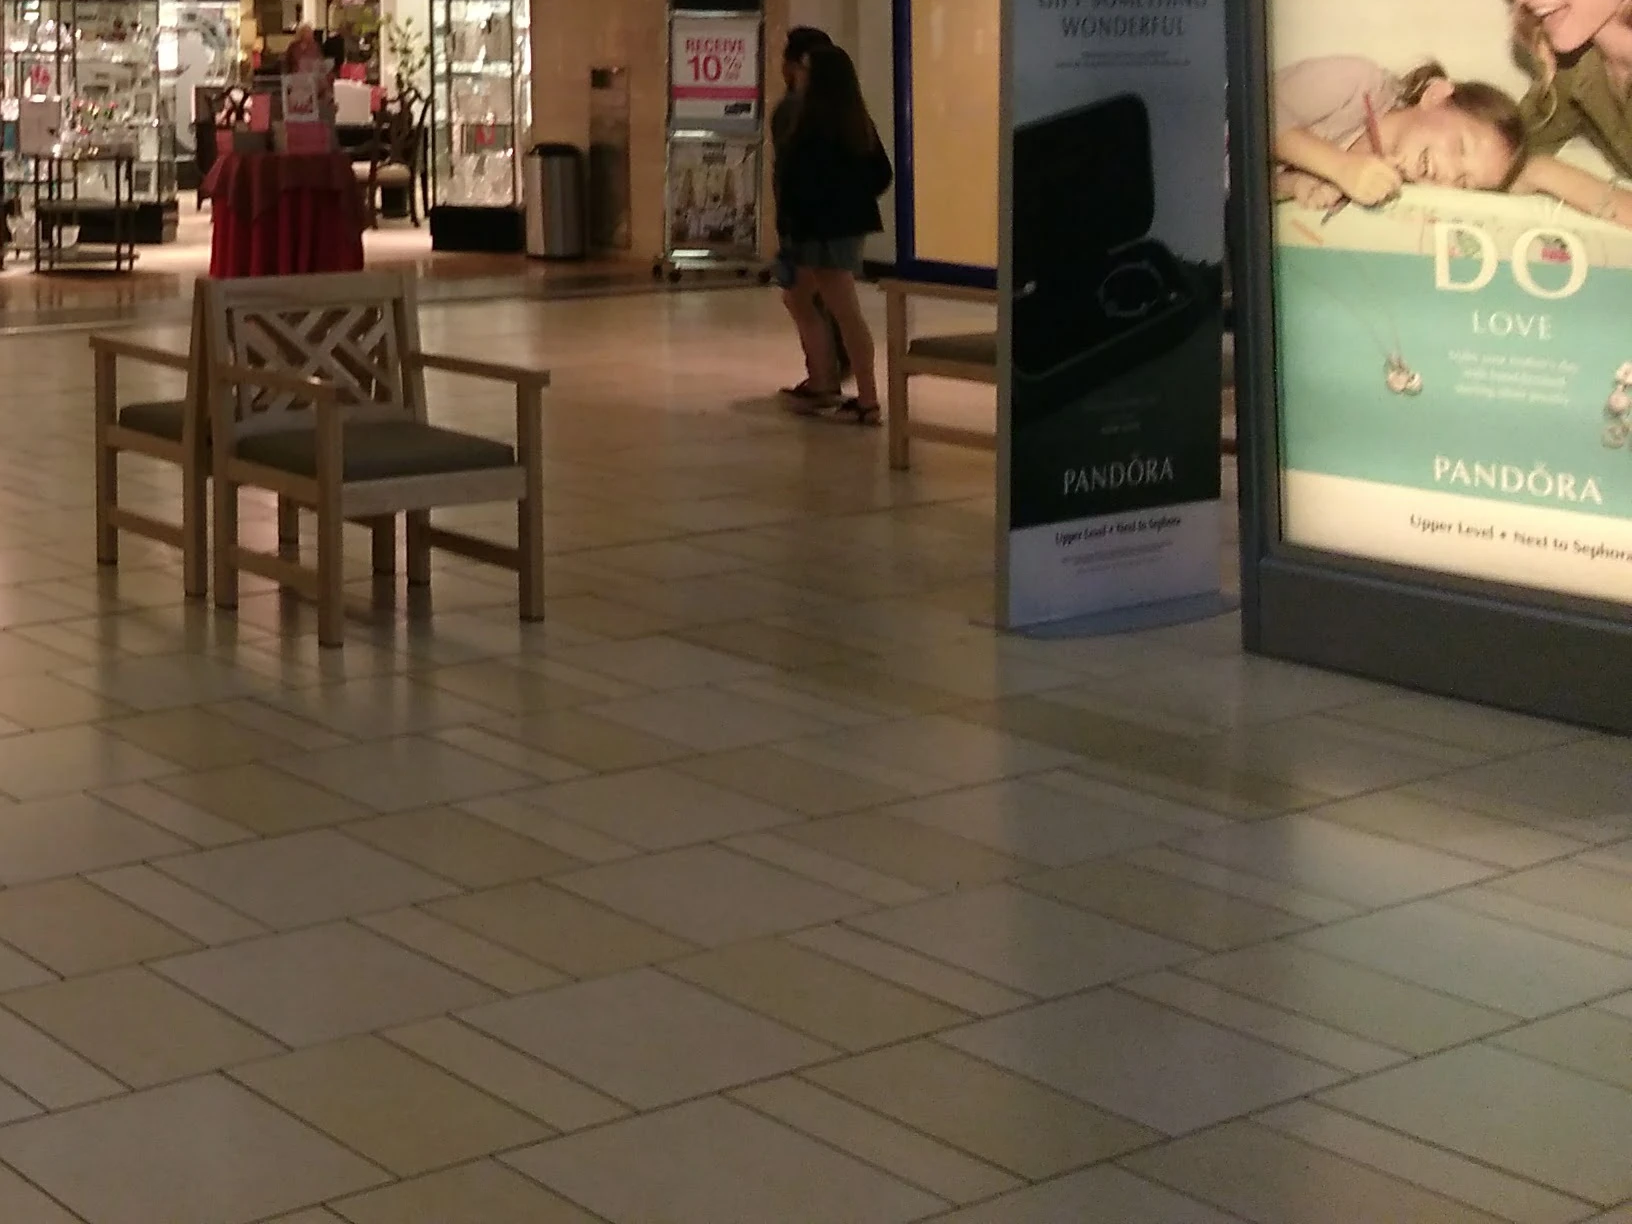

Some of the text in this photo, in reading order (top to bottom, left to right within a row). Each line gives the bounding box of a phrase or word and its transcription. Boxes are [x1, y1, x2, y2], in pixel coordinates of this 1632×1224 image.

[1061, 15, 1186, 38] WONDERFUL
[685, 38, 745, 54] RECEIVE
[1434, 222, 1588, 299] DO
[1472, 310, 1553, 341] LOVE
[1410, 513, 1452, 534] Upper
[1458, 521, 1495, 540] Level
[1514, 531, 1548, 548] Next
[1553, 537, 1568, 551] to
